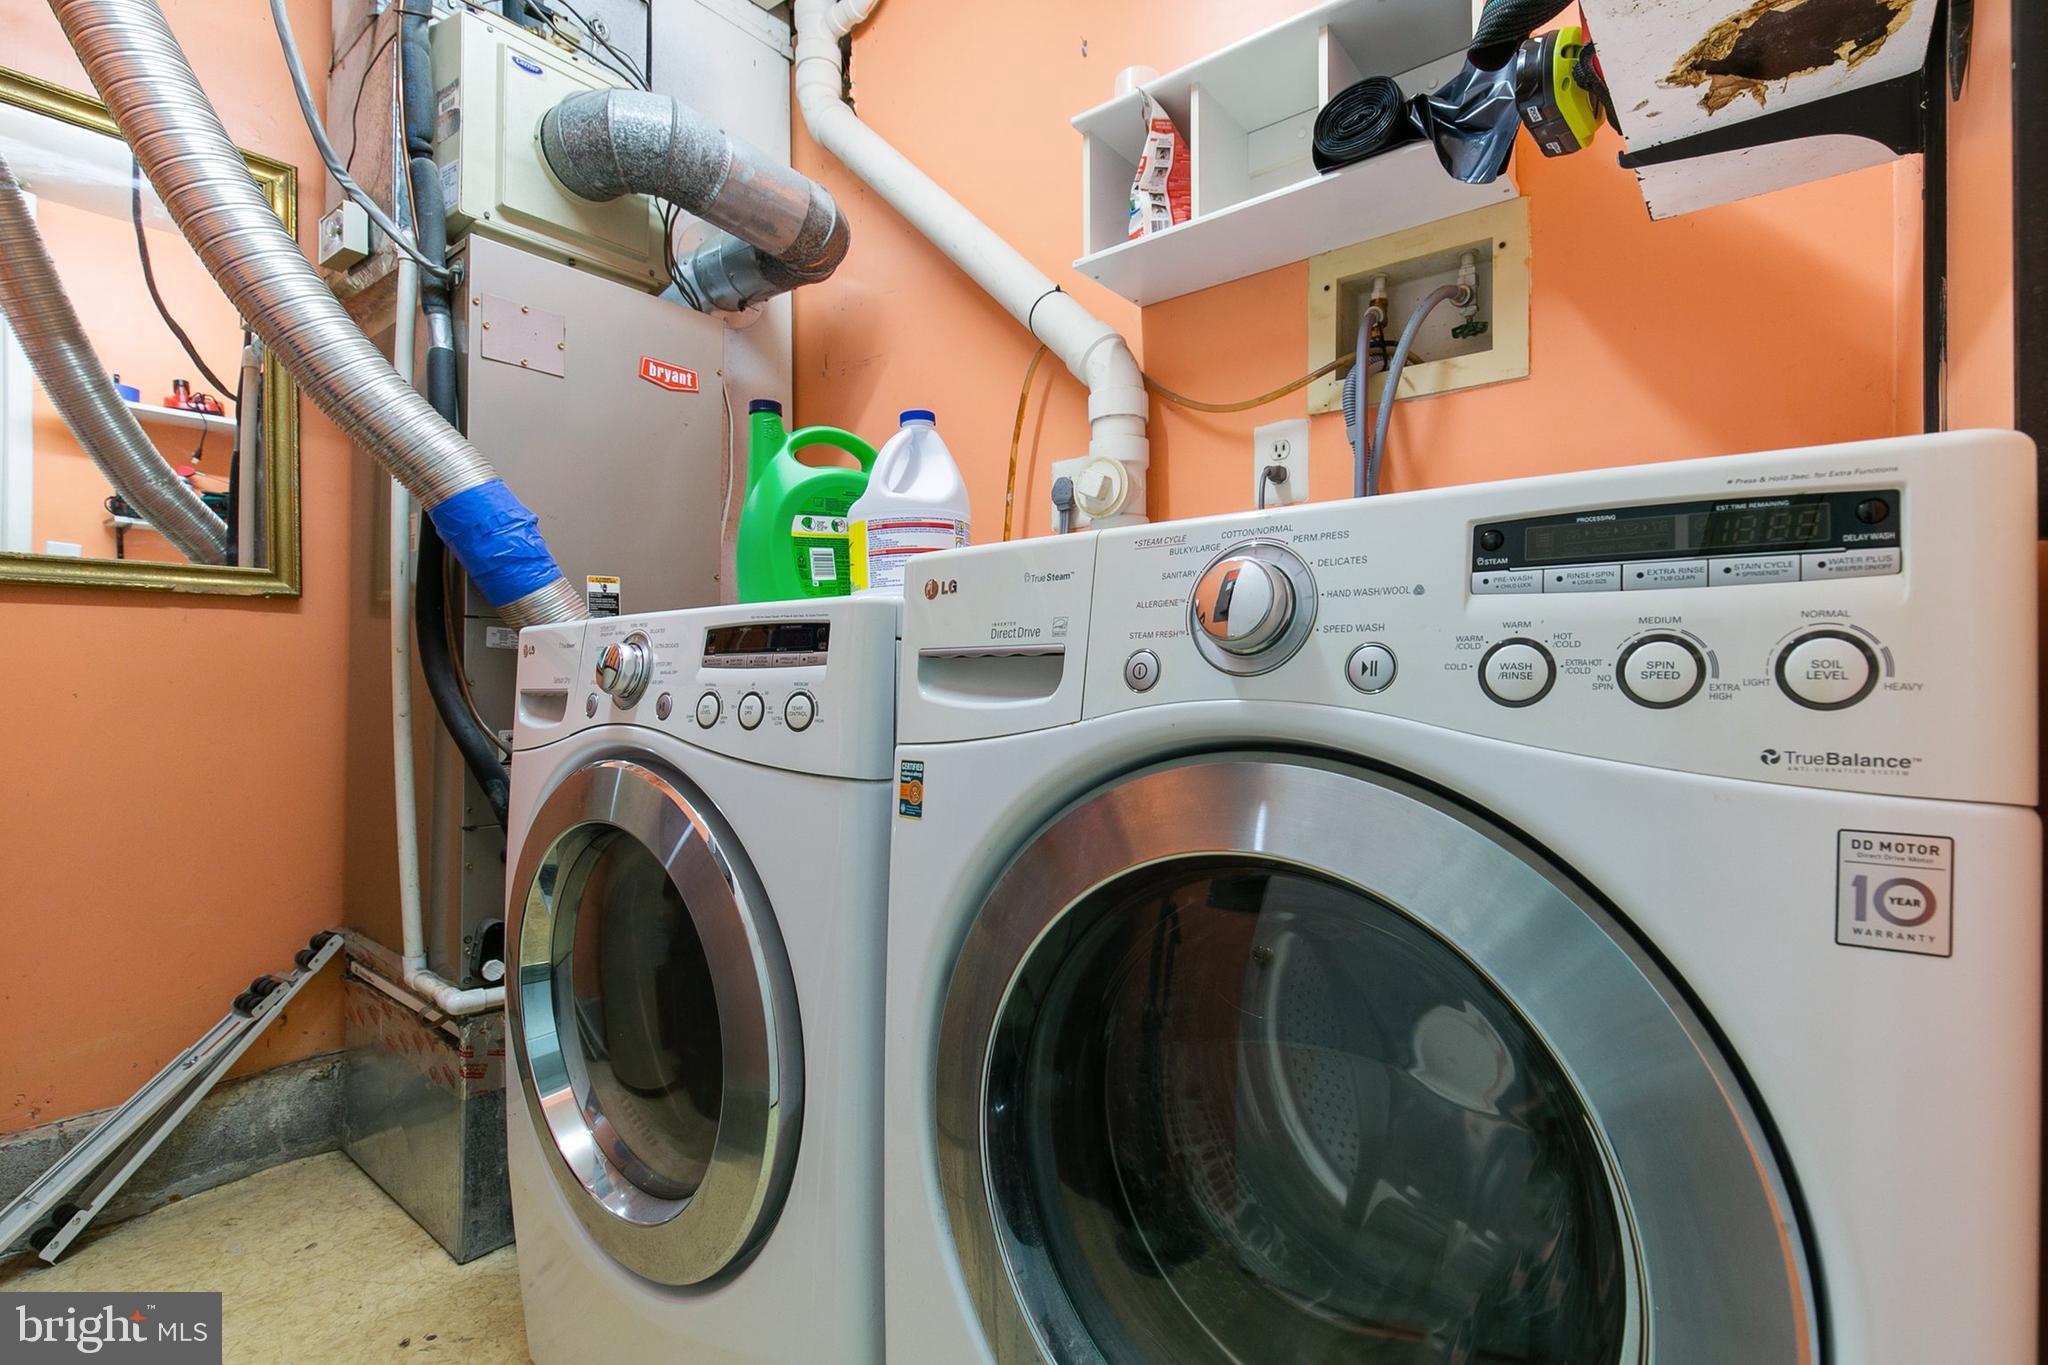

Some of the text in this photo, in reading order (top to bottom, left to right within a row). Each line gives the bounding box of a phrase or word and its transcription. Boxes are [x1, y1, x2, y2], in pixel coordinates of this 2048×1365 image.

[649, 362, 692, 386] bryant
[1854, 466, 1898, 476] Functions
[1748, 500, 1790, 509] REMAINING
[1576, 514, 1616, 523] PROCESSING
[1221, 525, 1293, 539] COTTON/NORMAL
[1842, 532, 1895, 542] DELAY WASH
[1138, 535, 1187, 547] STEAM CYCLE
[1170, 543, 1221, 556] BULKY/LARGE
[1317, 556, 1368, 567] DELICATES
[1484, 557, 1508, 566] STEAM
[1828, 555, 1892, 565] WATER PLUS
[1734, 560, 1793, 571] STAIN CYCLE
[1162, 570, 1197, 580] SANITARY
[1493, 575, 1533, 583] PRE-WASH
[1566, 571, 1615, 579] RINSE+SPIN
[941, 579, 958, 595] LG
[1326, 586, 1411, 598] HAND WASH/WOOL
[1801, 610, 1850, 618] NORMAL
[1638, 616, 1682, 624] MEDIUM
[990, 628, 1016, 639] Direct
[1018, 627, 1040, 638] Drive
[1323, 623, 1385, 633] SPEED WASH
[1129, 631, 1154, 640] STEAM
[1455, 642, 1481, 650] /COLD
[1552, 640, 1581, 648] /COLD
[1500, 663, 1533, 671] WASH
[1646, 661, 1675, 670] SPIN
[1811, 660, 1843, 669] SOIL
[1564, 666, 1591, 674] /COLD
[1640, 670, 1681, 680] SPEED
[1806, 670, 1848, 680] LEVEL
[1498, 671, 1533, 680] /RINSE
[1709, 684, 1741, 692] EXTRA
[1742, 679, 1770, 687] LIGHT
[1884, 683, 1923, 691] HEAVY
[1851, 839, 1940, 856] DD MOTOR
[1852, 874, 1937, 927] 10
[1888, 896, 1921, 908] YEAR
[1853, 928, 1936, 943] WARRANTY
